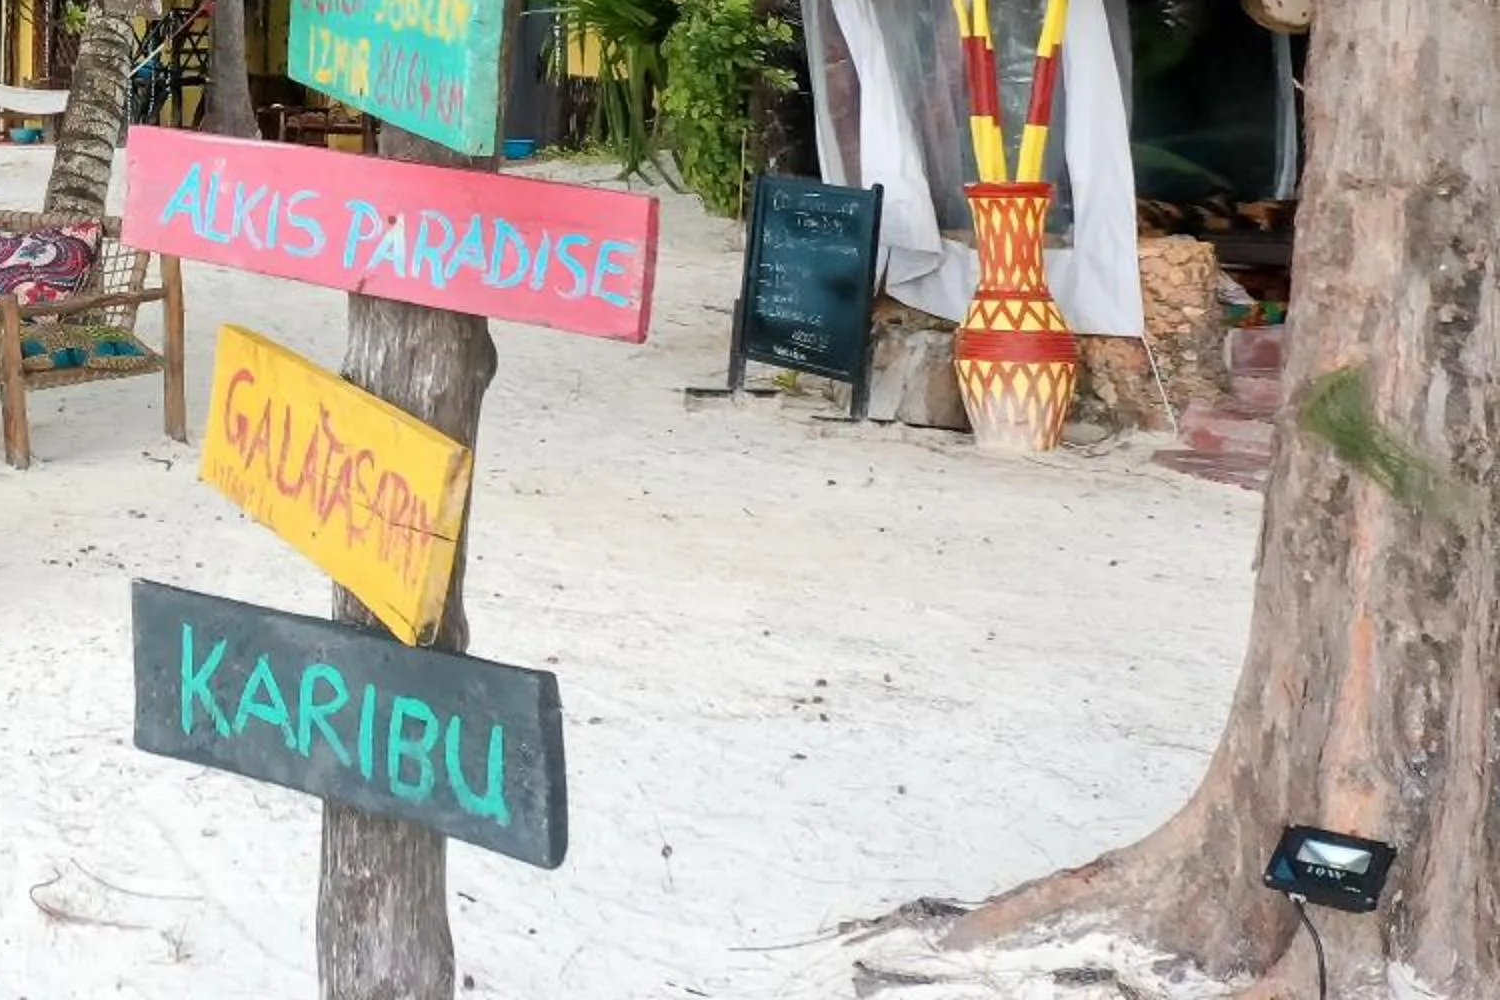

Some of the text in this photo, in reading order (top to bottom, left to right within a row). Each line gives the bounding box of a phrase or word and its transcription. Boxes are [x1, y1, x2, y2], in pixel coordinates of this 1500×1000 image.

[159, 163, 639, 307] ALKIS PARADISE
[181, 623, 510, 825] KARIBU
